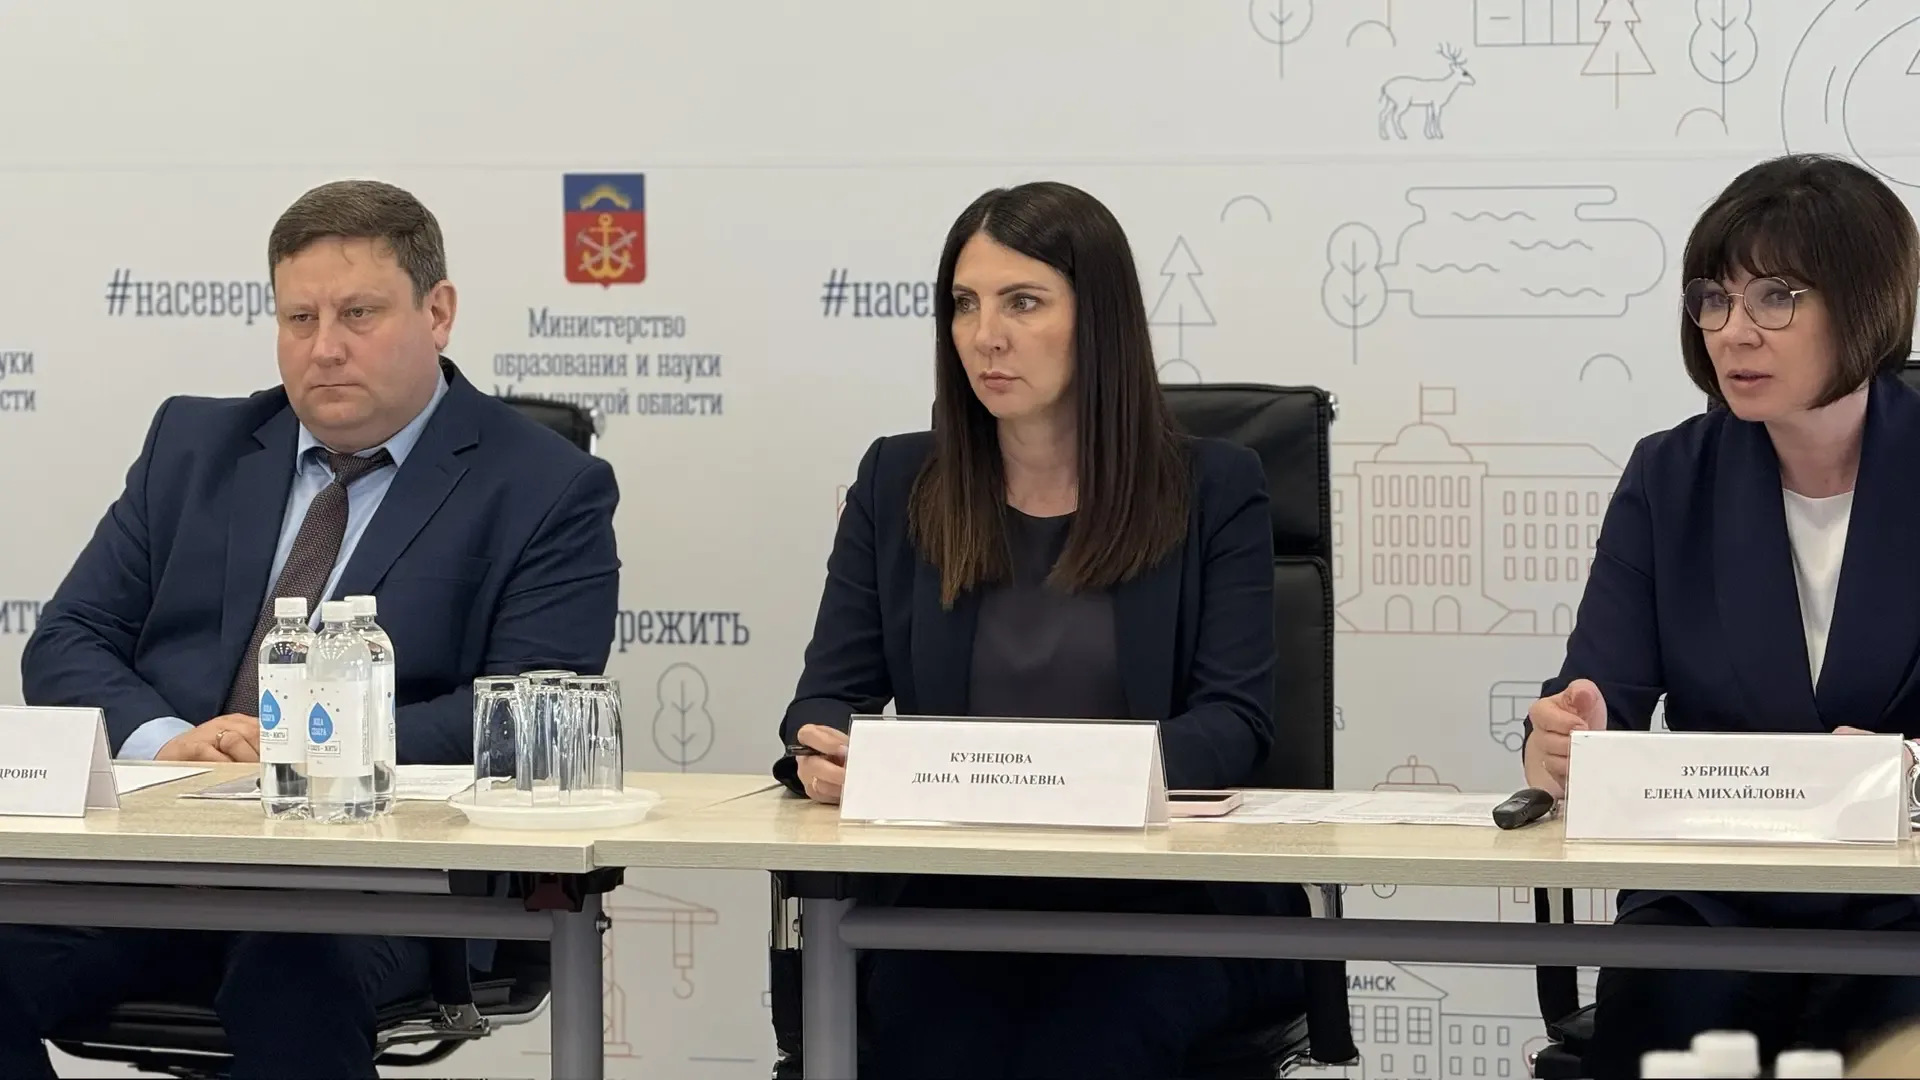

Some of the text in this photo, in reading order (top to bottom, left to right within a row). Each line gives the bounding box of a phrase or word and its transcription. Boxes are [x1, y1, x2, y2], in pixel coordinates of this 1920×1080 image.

[527, 307, 687, 344] Министерство
[0, 351, 34, 381] уки
[493, 353, 722, 383] образования и науки
[0, 389, 37, 412] сти
[637, 391, 724, 416] области
[618, 610, 751, 653] режить
[950, 752, 1032, 765] КУЗНЕЦОВА
[0, 768, 47, 779] ДРОВИЧ
[912, 772, 1066, 786] ДИАНА НИКОЛАЕВНА
[1681, 765, 1770, 778] ЗУБРИЦКАЯ
[1644, 785, 1806, 800] ЕЛЕНА МИХАЙЛОВНА
